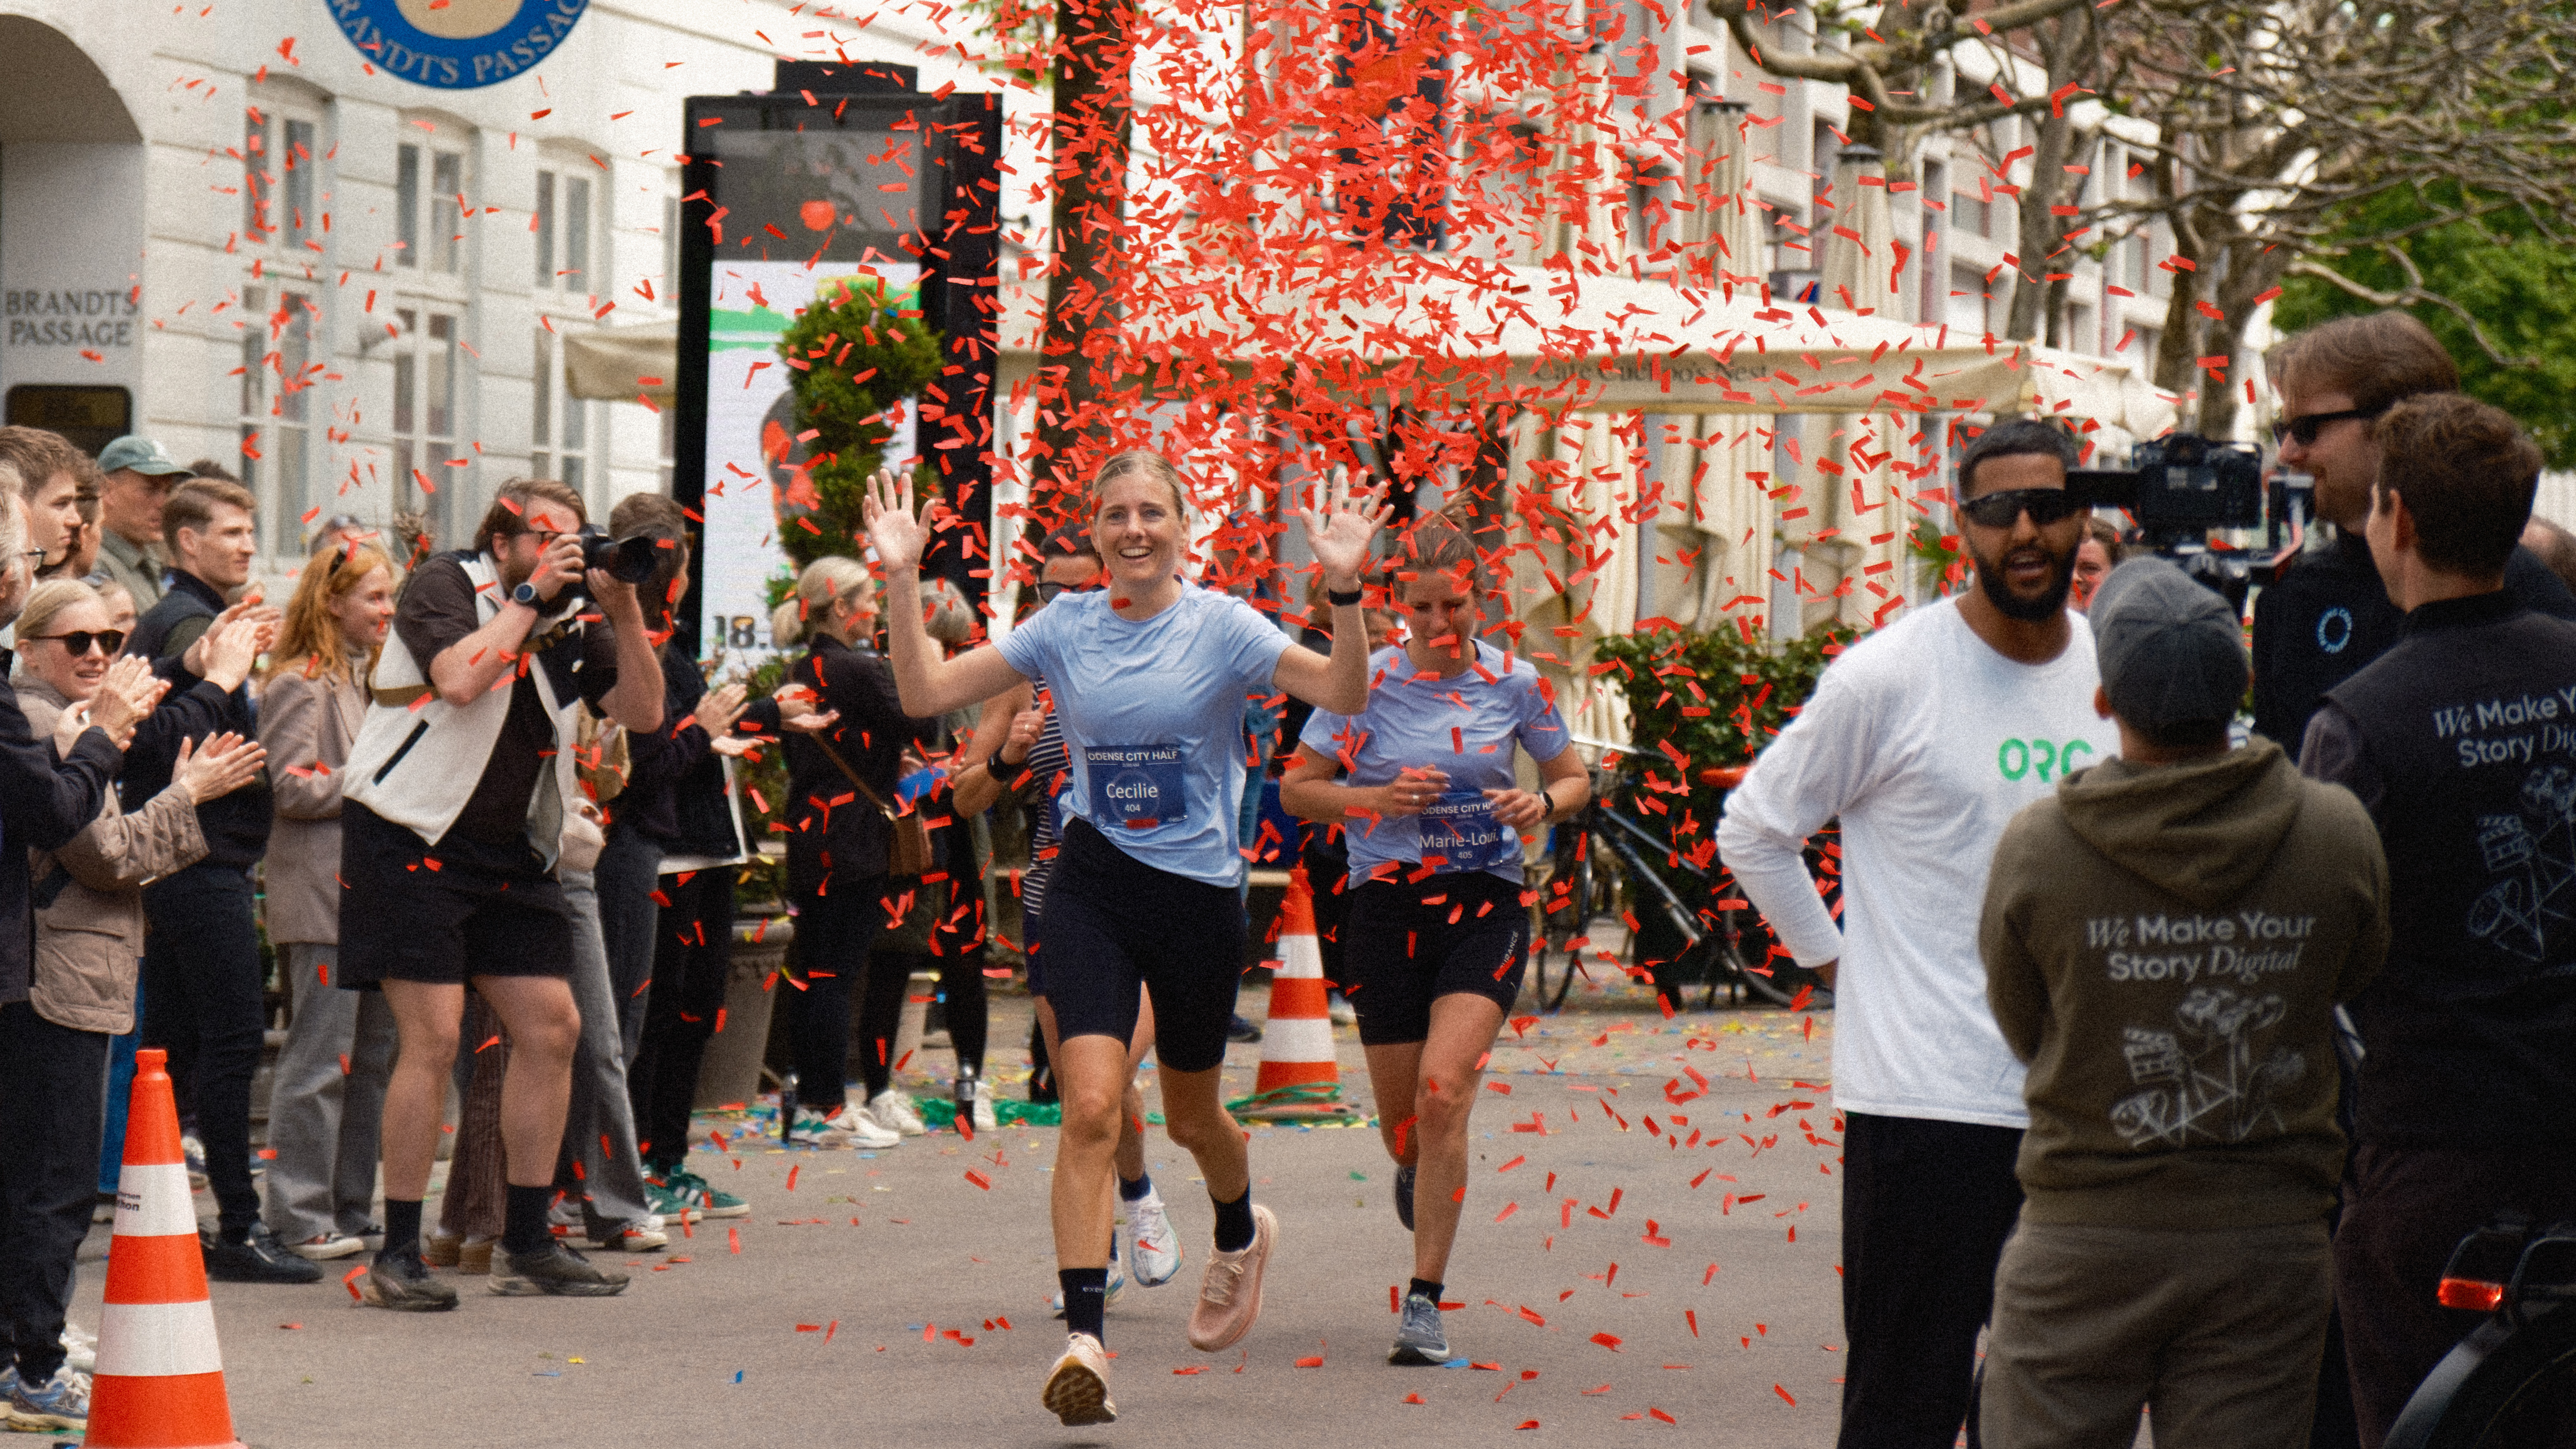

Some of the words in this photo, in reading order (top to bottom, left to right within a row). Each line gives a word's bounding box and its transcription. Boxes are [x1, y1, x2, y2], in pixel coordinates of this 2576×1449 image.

[6, 290, 139, 316] BRANDTS
[9, 319, 132, 346] PASSAGE
[2434, 704, 2472, 739] We
[2476, 695, 2559, 730] Make
[1088, 752, 1124, 761] ODENSE
[1126, 751, 1149, 761] CITY
[1152, 750, 1177, 760] HALF
[2458, 734, 2534, 767] Story
[1107, 783, 1158, 799] Cecilie
[1461, 804, 1481, 813] CITY
[1458, 851, 1473, 859] 405
[2087, 918, 2131, 949] We
[2136, 913, 2237, 946] Make
[2239, 911, 2315, 940] Your
[2107, 952, 2202, 984] Story
[2208, 941, 2305, 984] Digital
